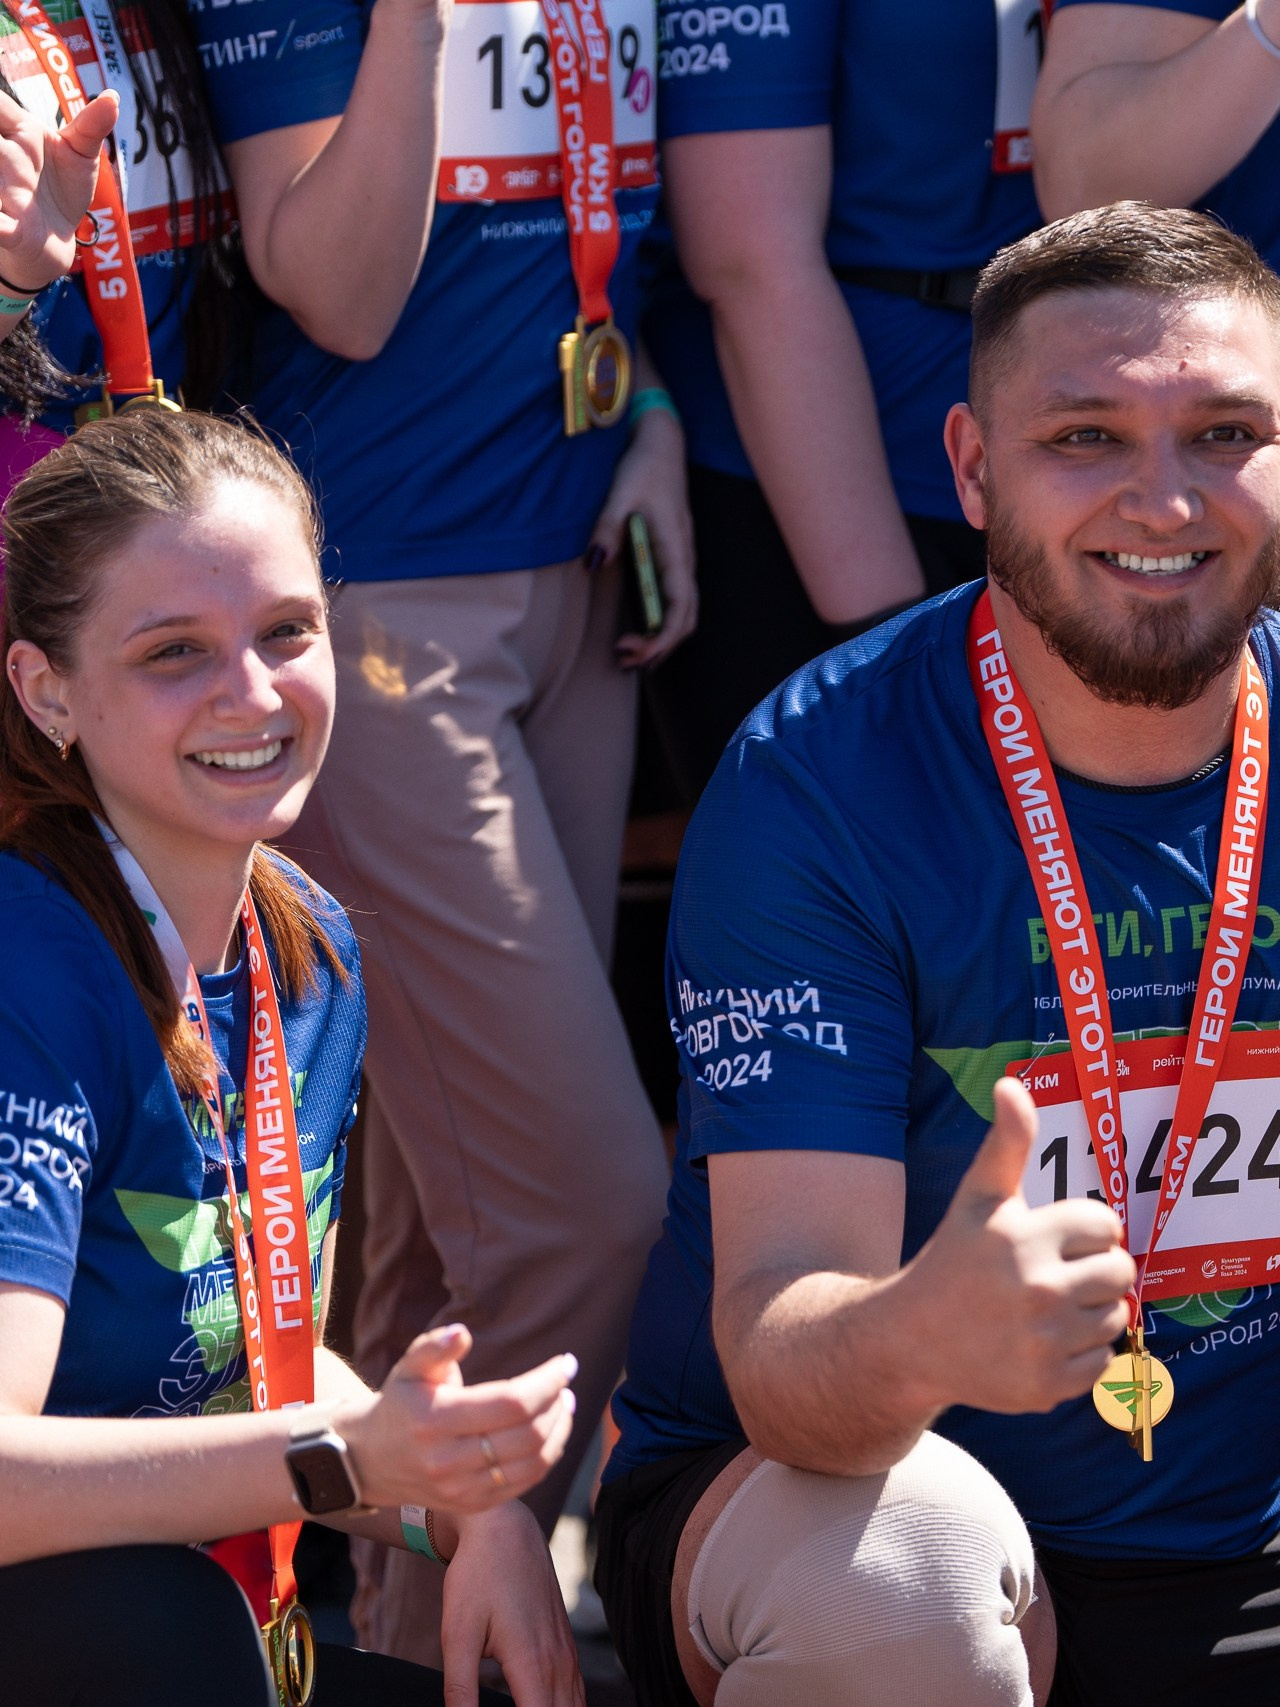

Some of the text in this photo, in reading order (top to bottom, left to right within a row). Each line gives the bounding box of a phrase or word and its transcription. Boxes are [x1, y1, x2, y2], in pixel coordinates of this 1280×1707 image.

[660, 2, 791, 41] ГОРОД
[198, 29, 278, 70] тинг
[477, 25, 639, 111] 139
[659, 42, 731, 79] 2024
[31, 22, 88, 120] ЕРОИ
[587, 142, 612, 232] 5 КМ
[88, 206, 127, 300] 5 КМ
[976, 628, 1035, 764] ГЕРОИ
[1012, 767, 1090, 956] МЕНЯЮТ
[1069, 965, 1110, 1078] ЭТОТ
[1194, 926, 1244, 1068] ГЕРОИ
[1223, 726, 1262, 920] МЕНЯЮТ
[1153, 1054, 1185, 1071] рейт
[1246, 1046, 1280, 1056] НИЖНИЙ
[253, 986, 289, 1177] МЕНЯЮТ
[1022, 1072, 1059, 1092] 5 КМ
[0, 1091, 88, 1149] НИЙ
[0, 1132, 91, 1191] ОРОД
[1165, 1134, 1193, 1200] КМ
[0, 1173, 39, 1211] 24
[262, 1184, 304, 1330] ГЕРОИ
[1143, 1267, 1186, 1280] ЖЕГОРОДСКАЯ
[1220, 1256, 1251, 1264] Культурная
[1220, 1263, 1244, 1271] Столица
[1220, 1269, 1248, 1278] Года 2024
[1142, 1277, 1164, 1286] БЛАСТЬ
